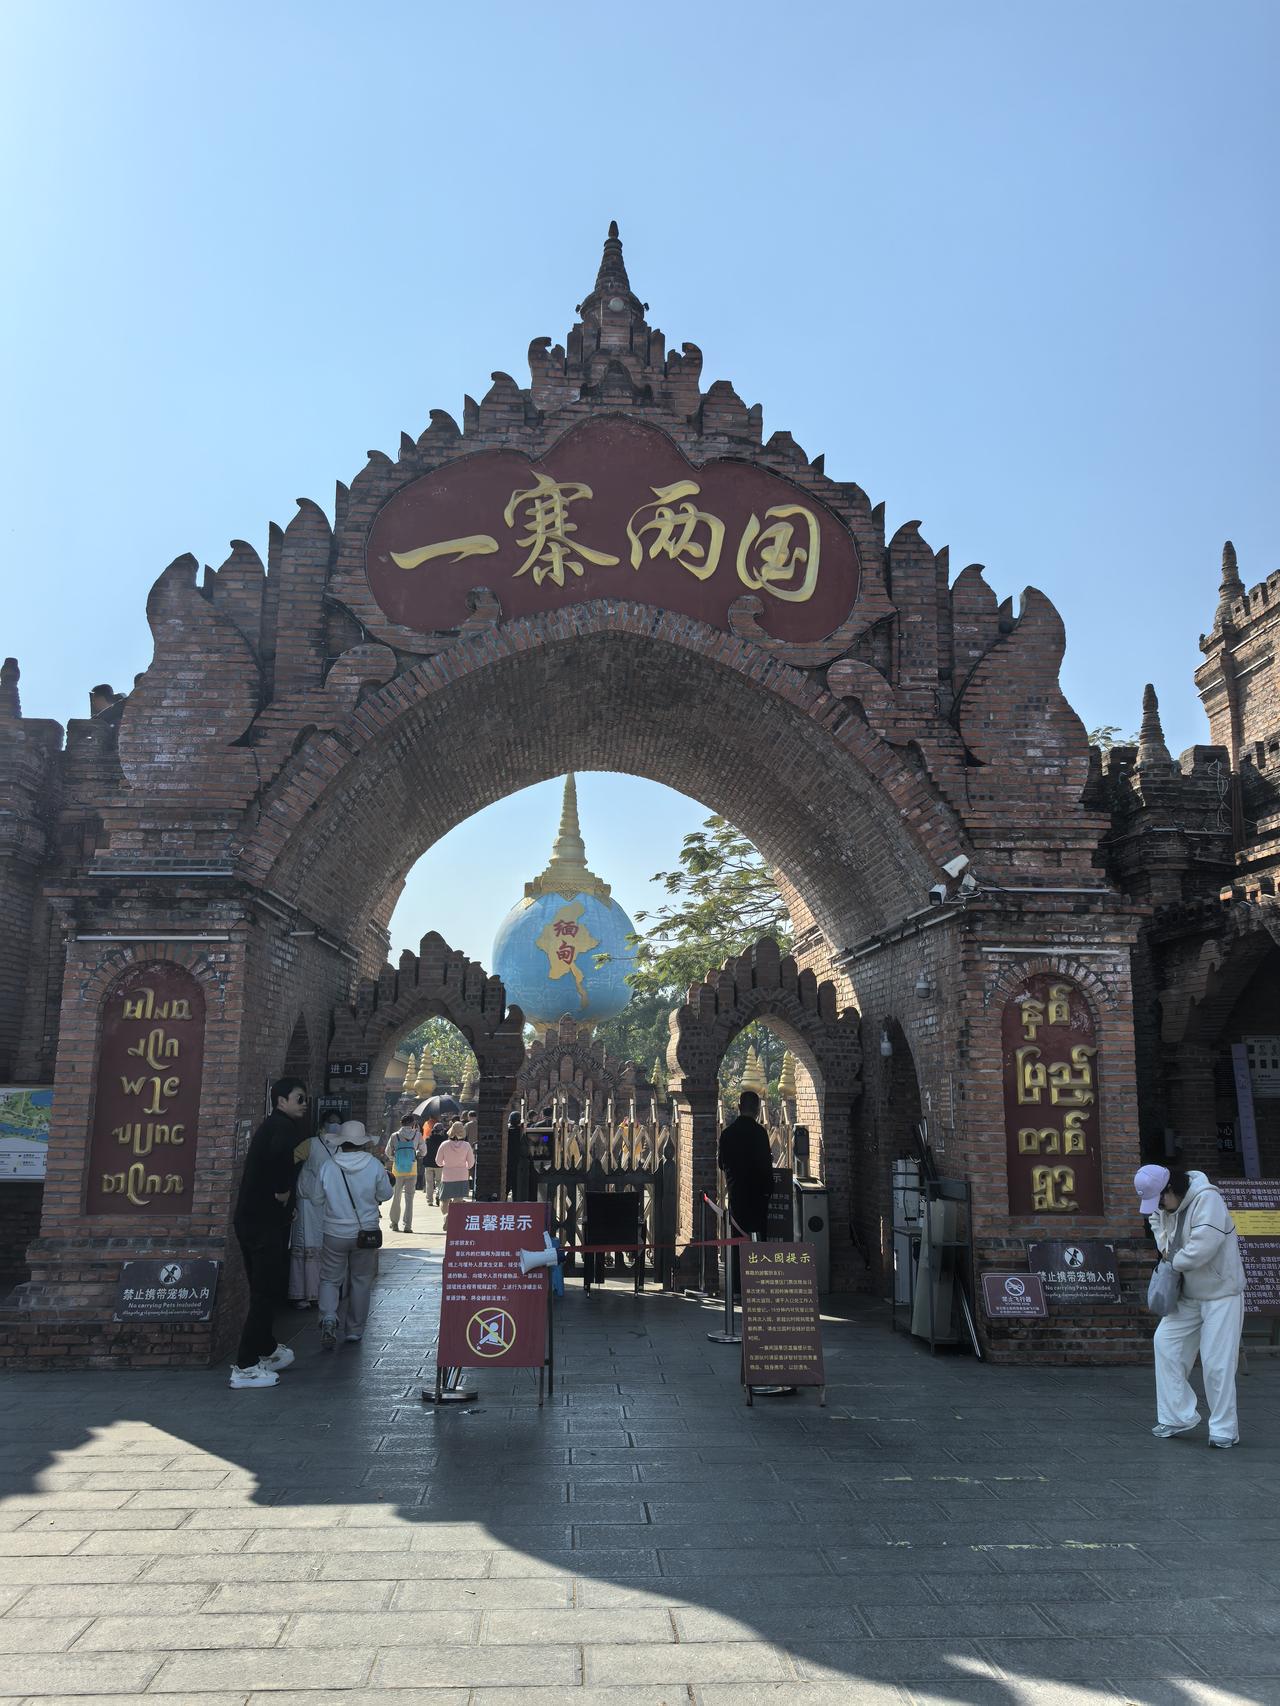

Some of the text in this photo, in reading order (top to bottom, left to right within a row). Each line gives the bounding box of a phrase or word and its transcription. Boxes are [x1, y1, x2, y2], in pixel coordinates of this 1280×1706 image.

[390, 470, 820, 601] 一寨两国
[553, 919, 579, 965] 缅甸
[330, 1063, 352, 1074] 进口
[464, 1214, 533, 1231] 温馨提示
[1038, 1271, 1115, 1283] 禁止携带宠物入内
[122, 1287, 210, 1301] 禁止携带宠物入内
